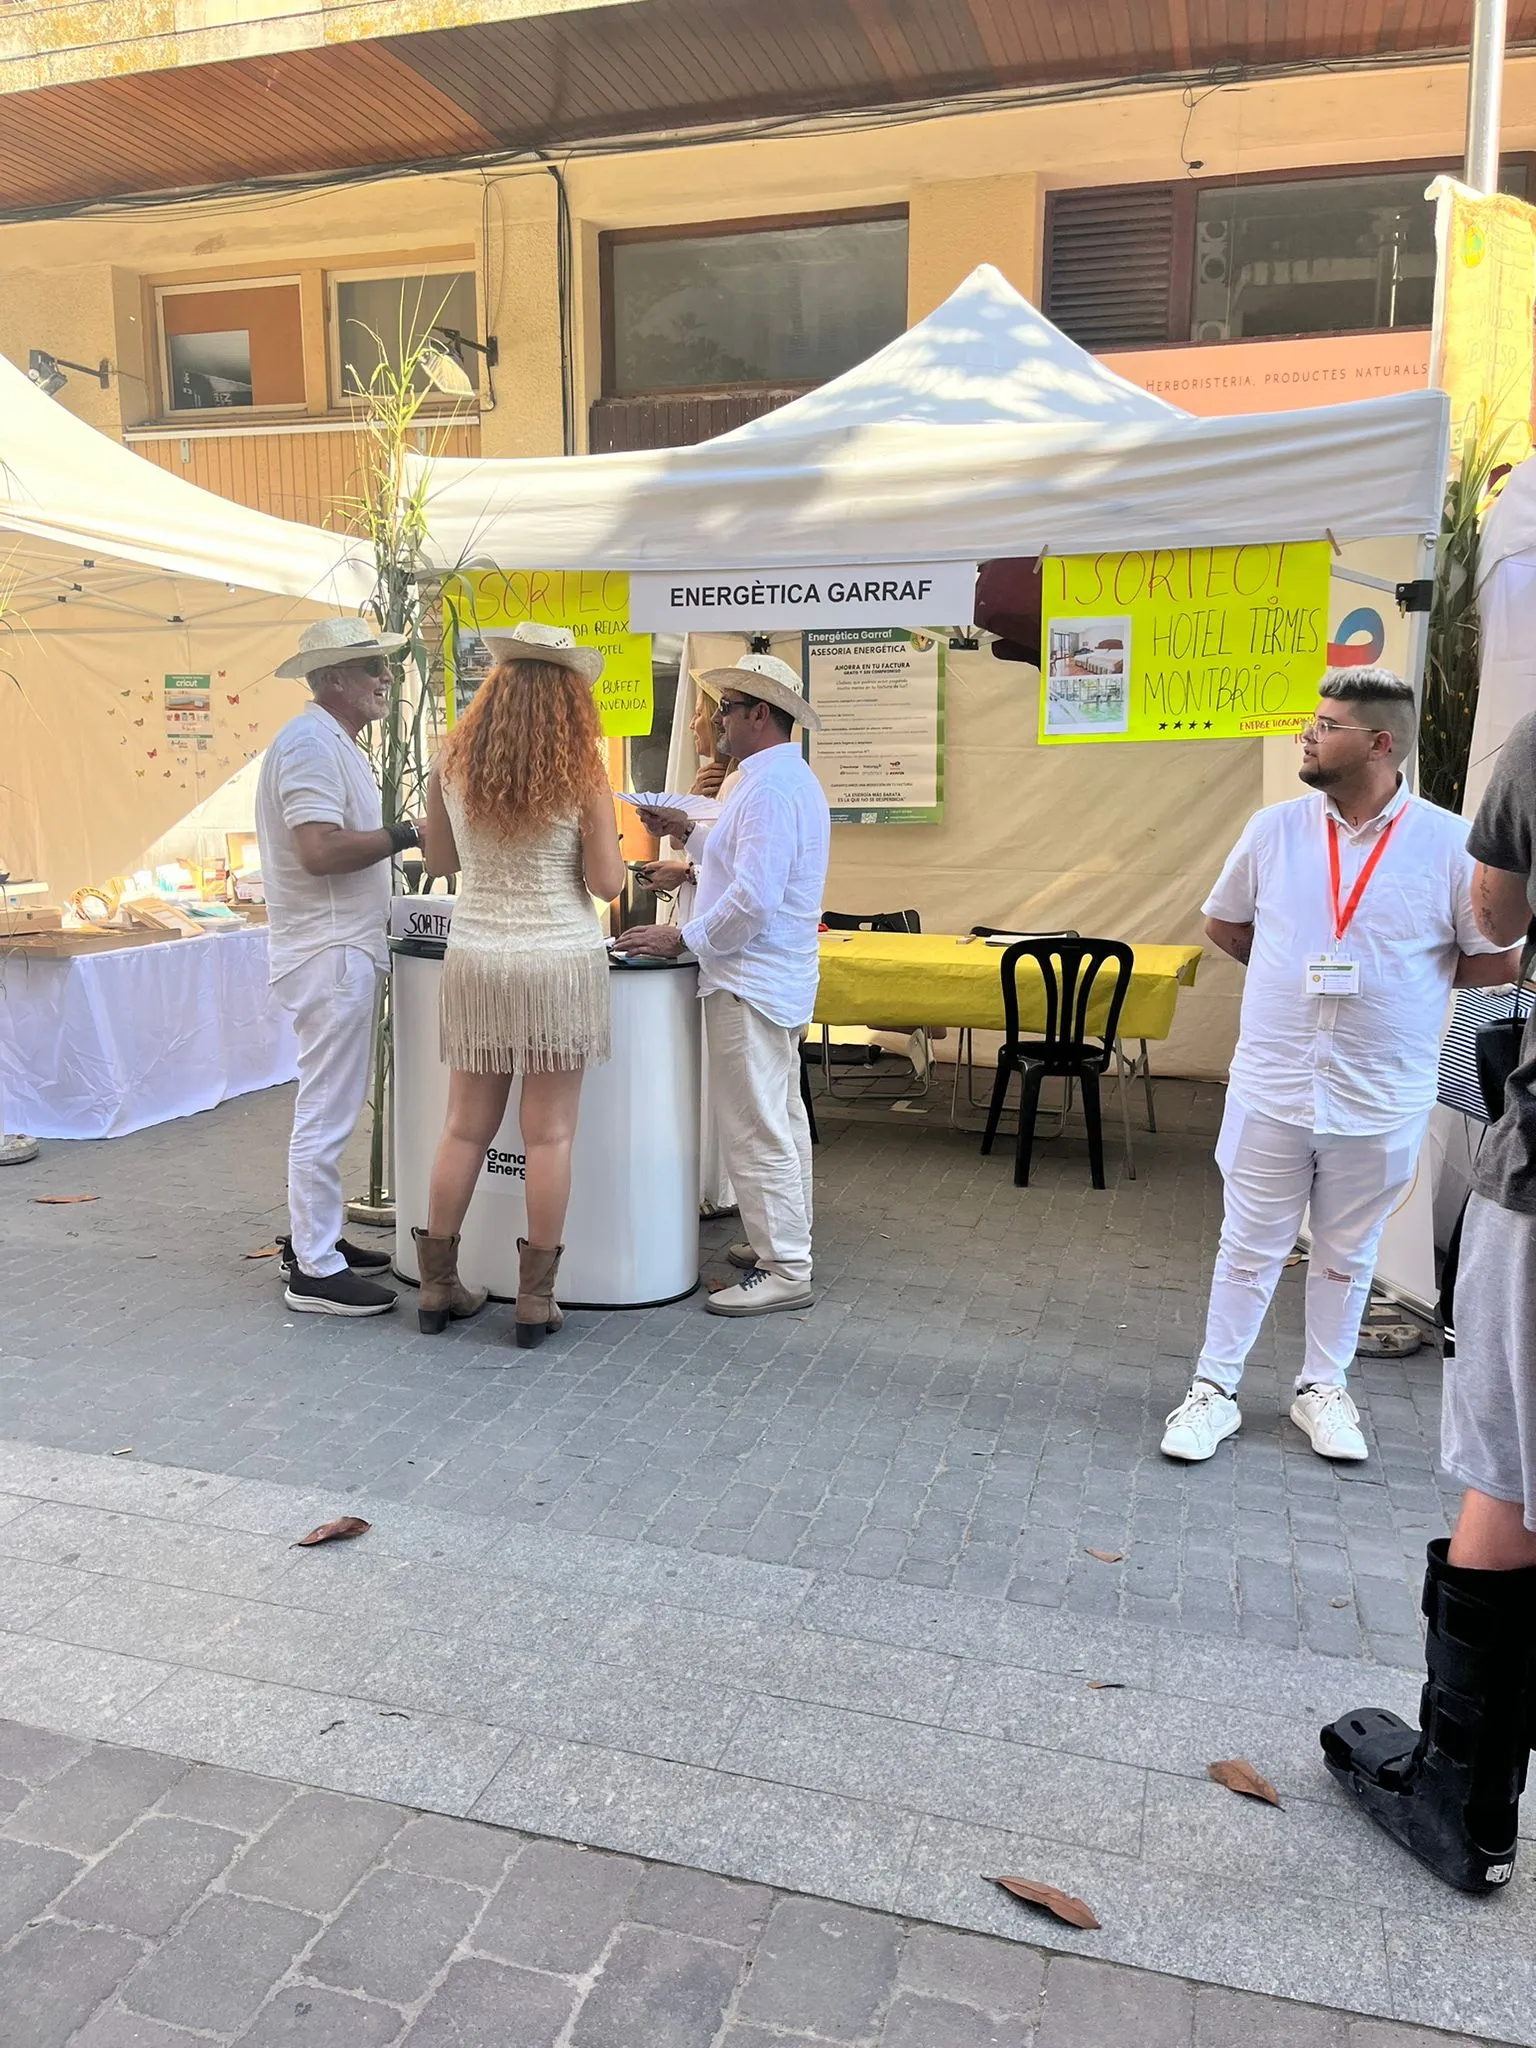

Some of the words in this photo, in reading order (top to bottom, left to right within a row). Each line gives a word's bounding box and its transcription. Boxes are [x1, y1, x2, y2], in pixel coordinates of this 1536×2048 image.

[1264, 368, 1347, 385] PRODUCTES
[1355, 363, 1429, 379] NATURALS
[670, 579, 821, 607] ENERGÈTICA
[827, 579, 932, 603] GARRAF
[594, 620, 630, 636] RELAX
[808, 630, 859, 643] Energética
[860, 629, 892, 639] Garraf
[1153, 610, 1233, 659] HOTEL
[175, 679, 198, 688] cricut
[602, 679, 641, 695] BUFFET
[486, 1148, 526, 1165] Gana
